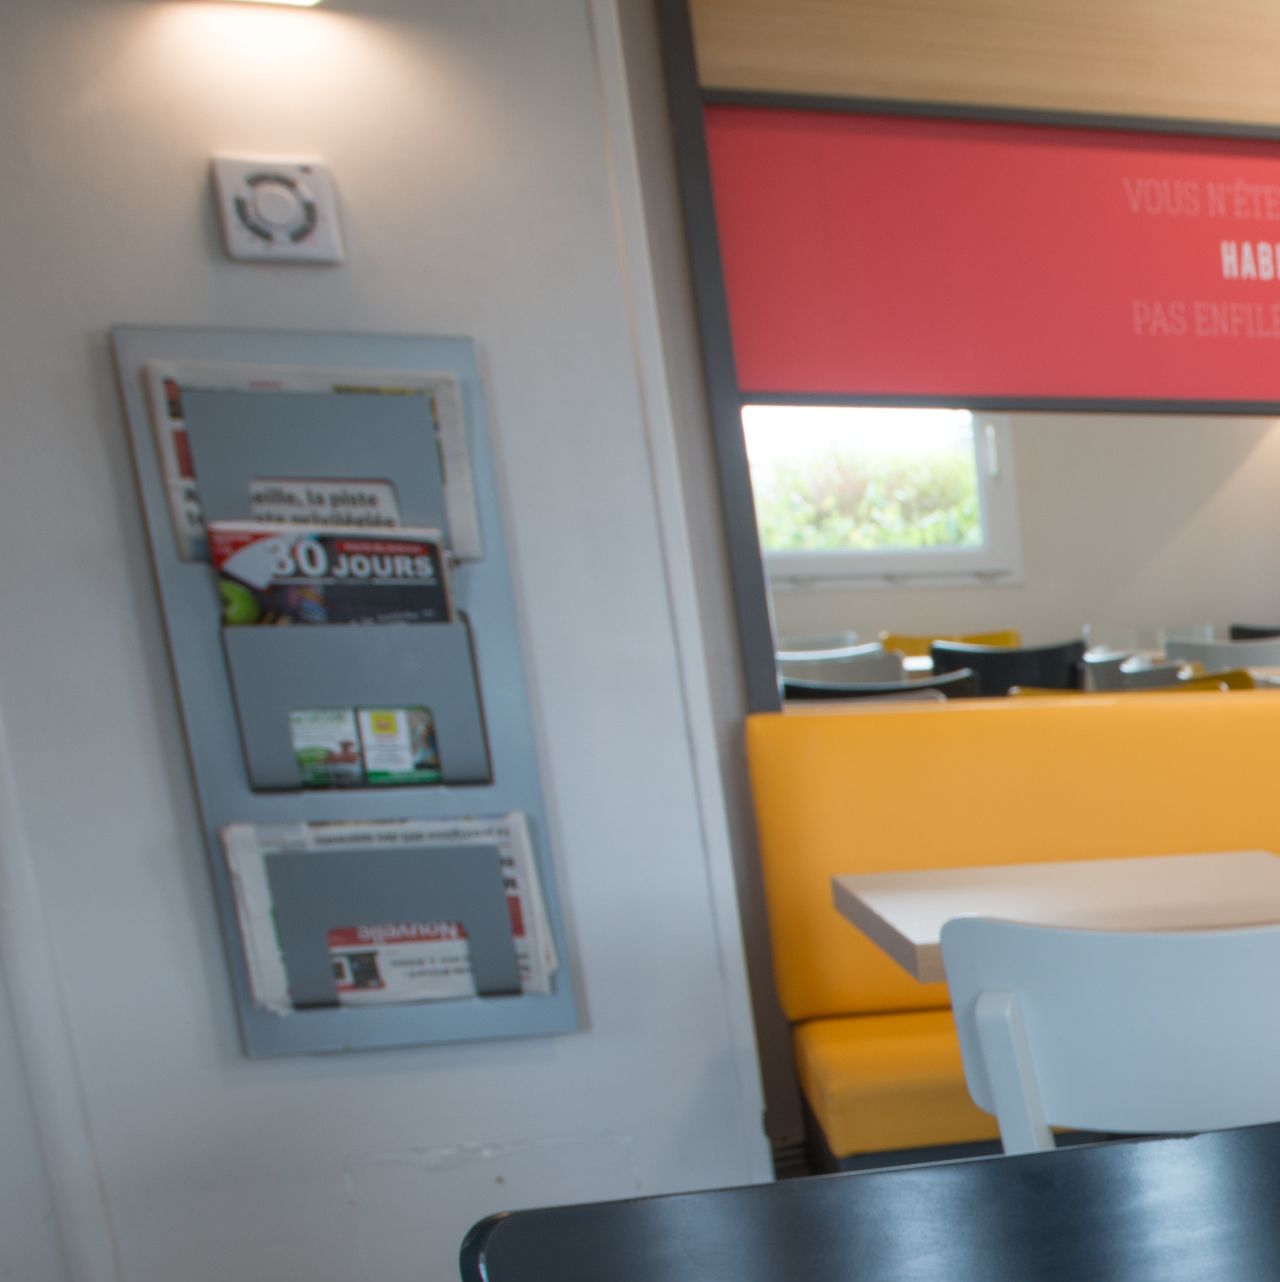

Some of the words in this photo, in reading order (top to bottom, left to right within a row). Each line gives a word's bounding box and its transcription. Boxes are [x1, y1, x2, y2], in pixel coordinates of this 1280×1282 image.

[1122, 177, 1200, 216] VOUS
[1131, 299, 1187, 336] PAS
[270, 538, 328, 577] 30
[332, 553, 434, 578] JOURS
